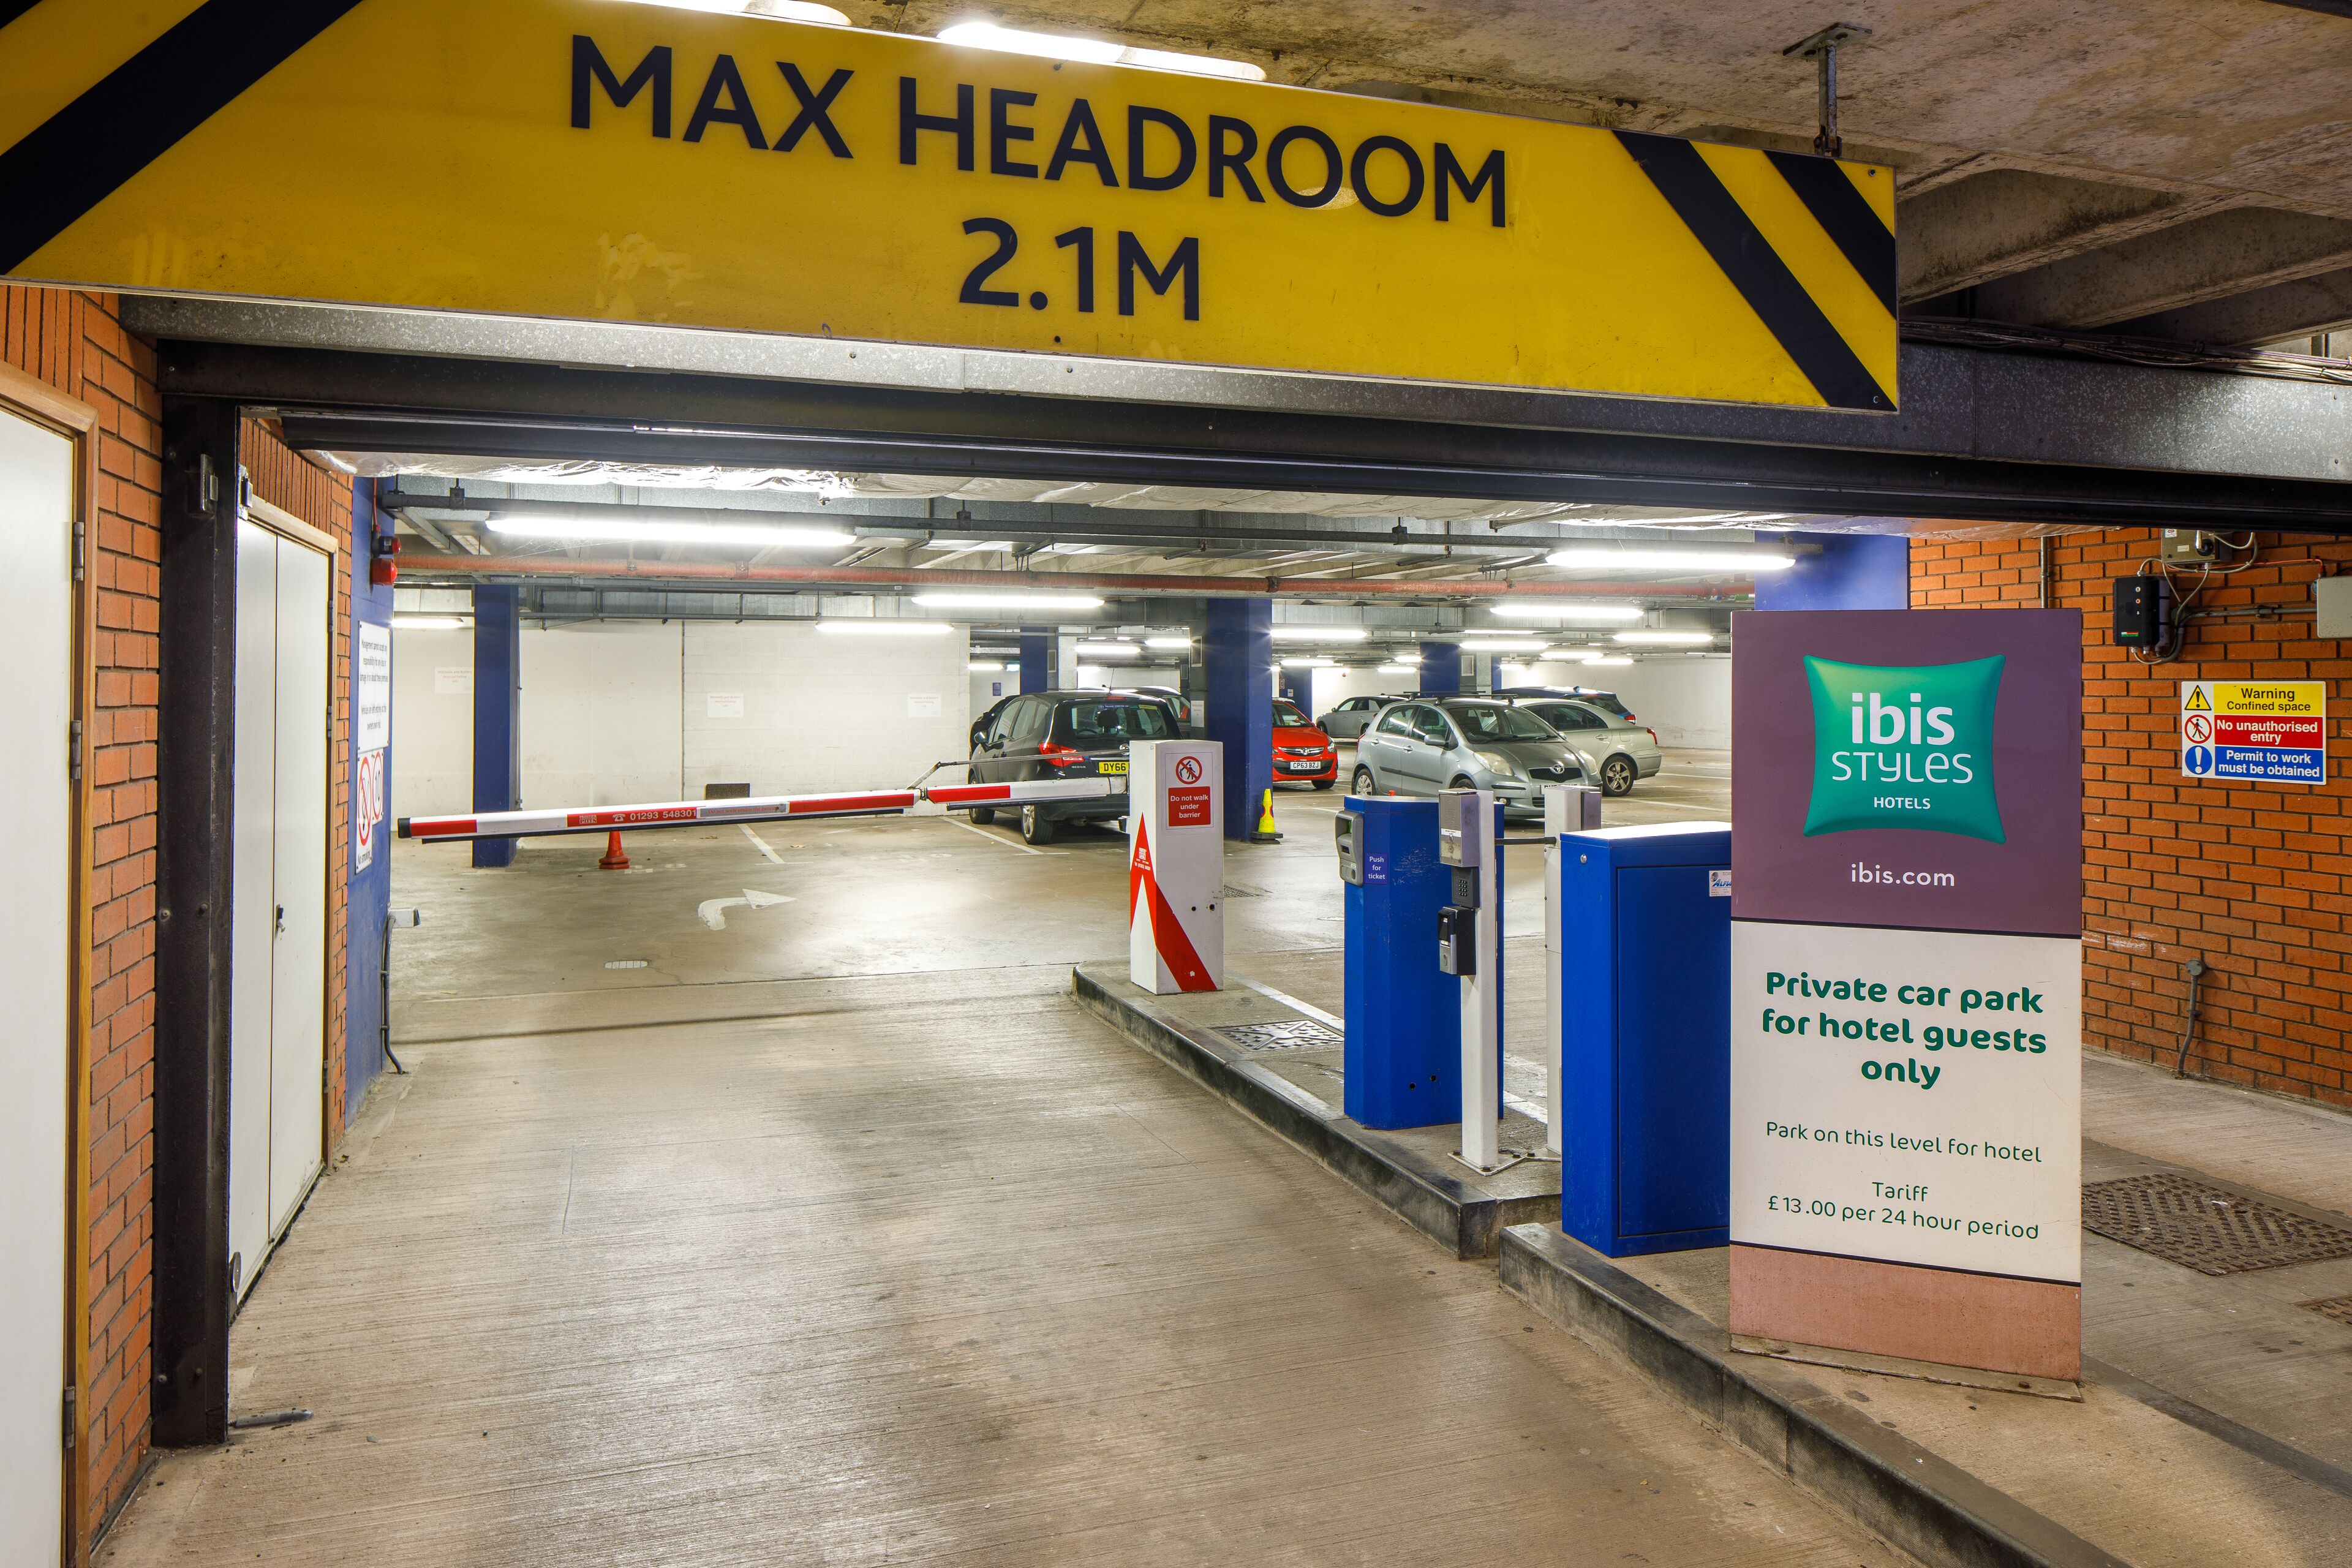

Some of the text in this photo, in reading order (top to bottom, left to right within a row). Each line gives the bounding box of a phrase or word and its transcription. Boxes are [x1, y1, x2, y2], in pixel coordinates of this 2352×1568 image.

[571, 34, 1507, 228] MAX HEADROOM
[960, 217, 1200, 322] 2.1M
[2241, 688, 2295, 701] Warning
[2227, 701, 2311, 713] Confined space
[1851, 693, 1954, 745] ibis
[2217, 720, 2318, 733] No unauthorised
[2250, 732, 2282, 745] entry
[1104, 763, 1126, 772] DY66
[2226, 750, 2312, 764] Permit to work
[2218, 764, 2320, 777] must be obtained
[375, 770, 381, 802] 10
[1874, 797, 1931, 810] HOTELS
[630, 809, 696, 821] 01293 548301
[1851, 862, 1954, 887] ibis.com
[1766, 971, 2043, 1014] Private car park
[1762, 1008, 2046, 1054] for hotel guests
[1861, 1058, 1940, 1090] only
[1766, 1121, 2042, 1163] Park on this level for hotel
[1872, 1182, 1929, 1202] Tariff
[1842, 1206, 1875, 1222] per
[1882, 1208, 1906, 1224] 24
[1913, 1211, 1961, 1231] hour
[1967, 1219, 2038, 1239] period
